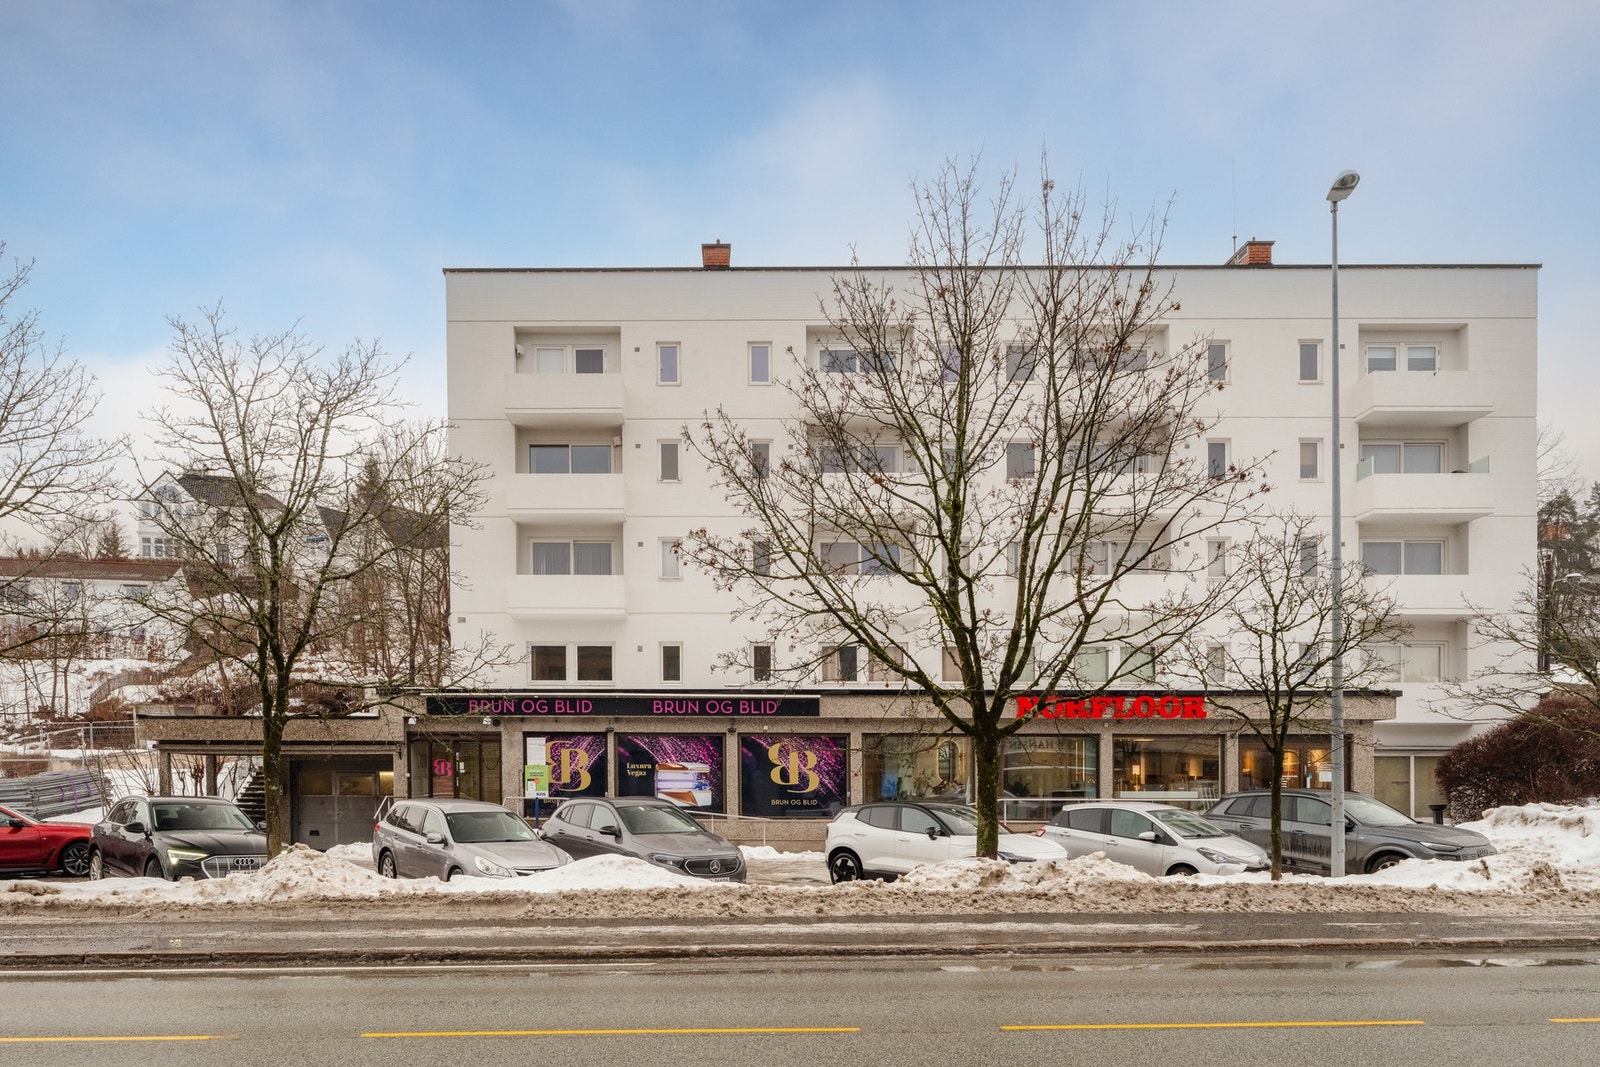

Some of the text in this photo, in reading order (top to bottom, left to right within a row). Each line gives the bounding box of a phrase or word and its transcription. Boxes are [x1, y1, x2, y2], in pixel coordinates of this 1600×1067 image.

[468, 699, 593, 714] BRUN OG BLID
[653, 700, 778, 715] BRUN OG BLID
[626, 769, 647, 778] Vegaz
